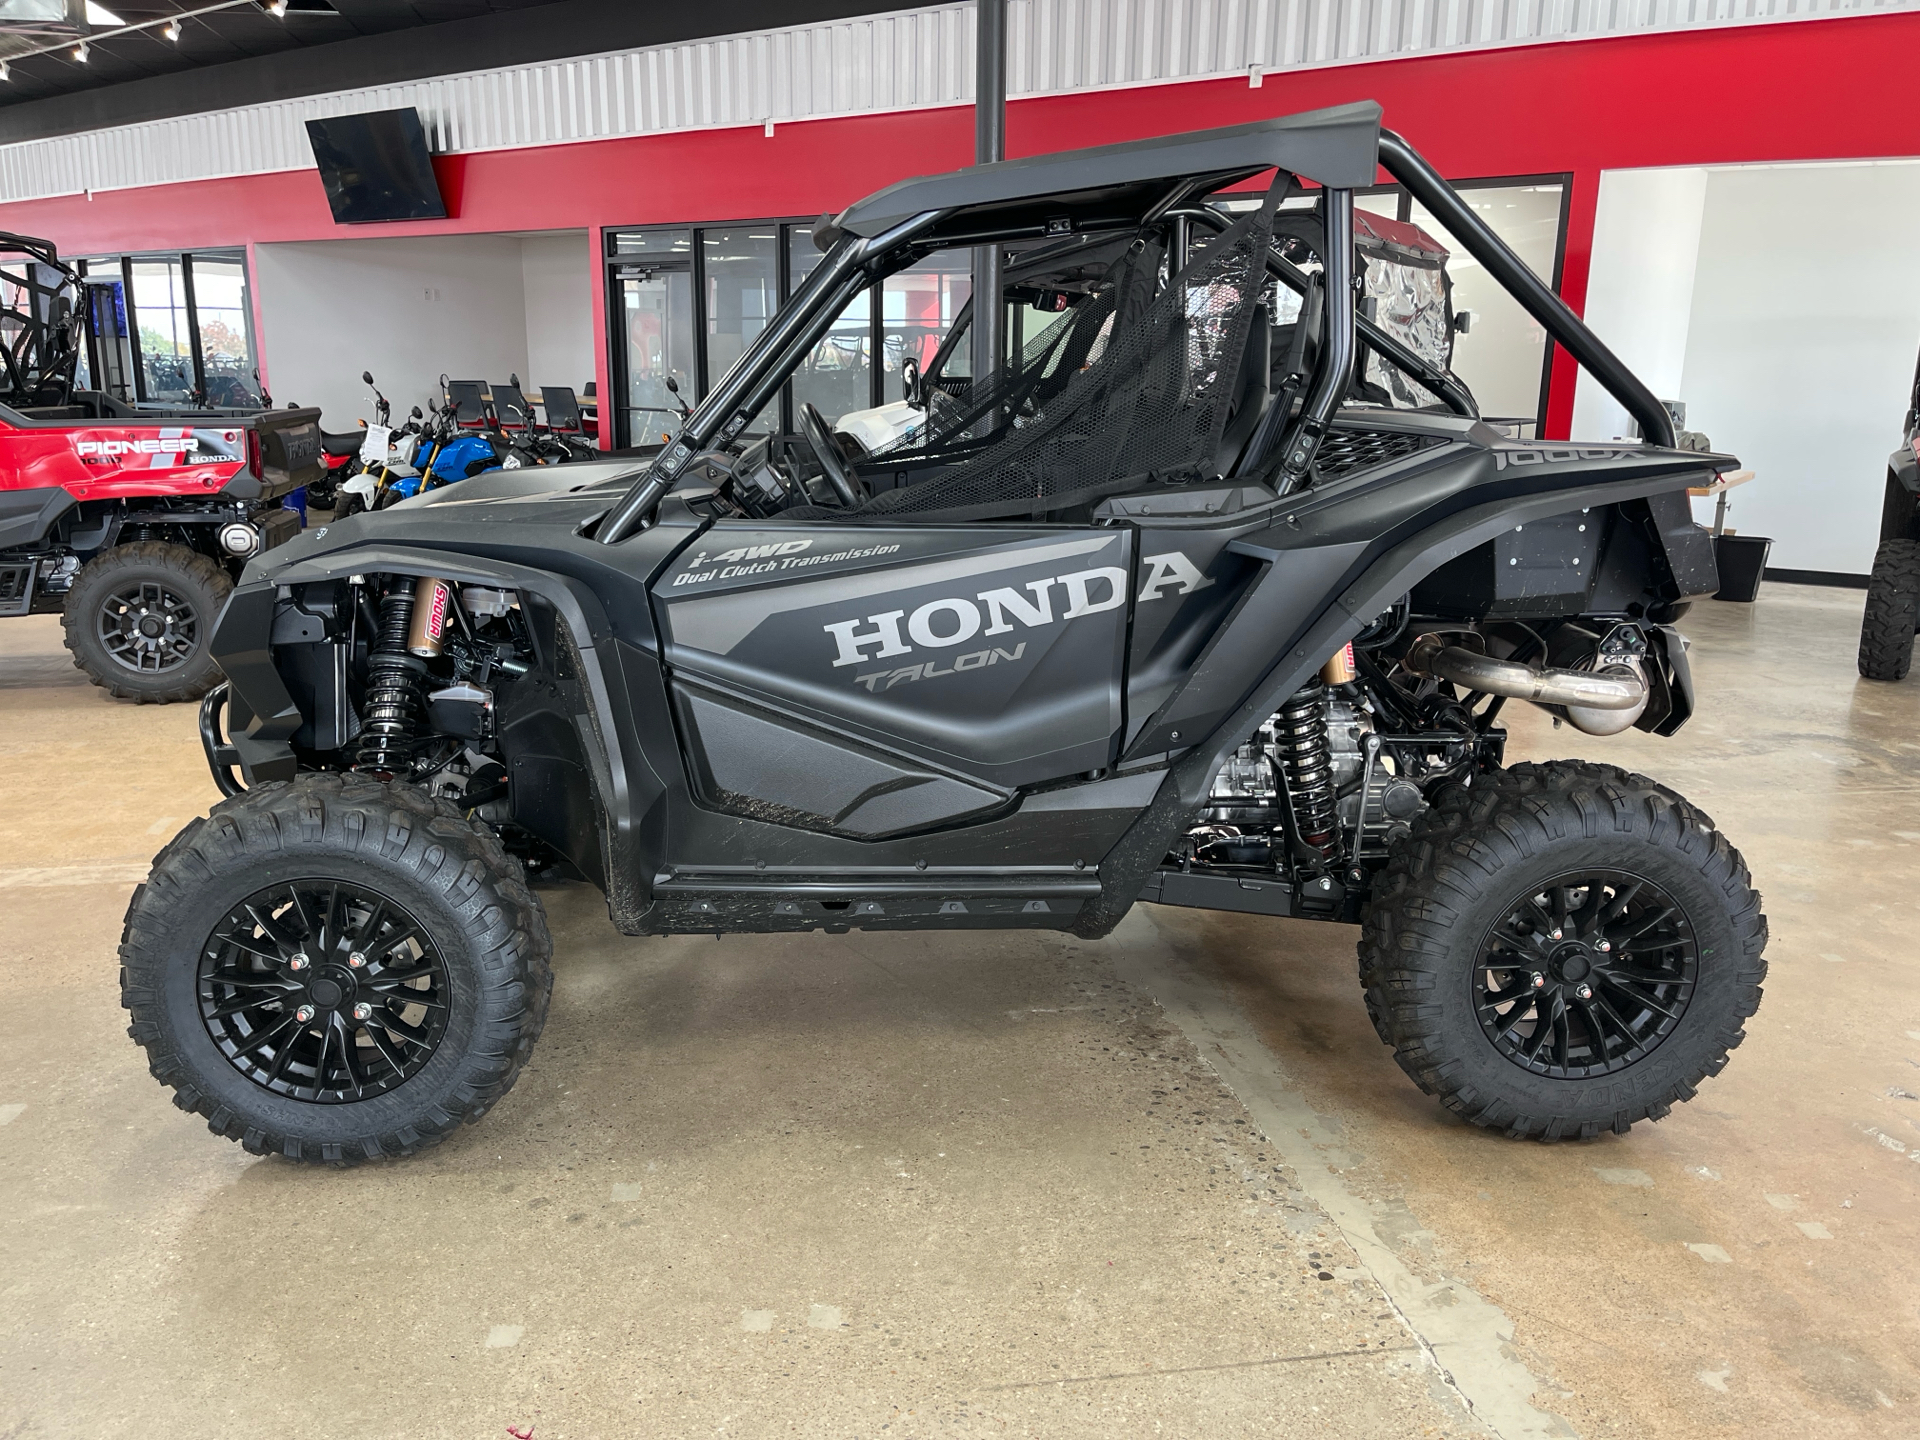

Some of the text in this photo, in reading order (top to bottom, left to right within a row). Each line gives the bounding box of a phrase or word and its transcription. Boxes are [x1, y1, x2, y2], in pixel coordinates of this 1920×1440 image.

[77, 438, 199, 456] PIONEER
[189, 453, 238, 465] HONDA
[1492, 449, 1647, 471] 1000X
[671, 544, 901, 587] Dual Clutch Transmission
[687, 539, 814, 569] i-4WD
[428, 584, 449, 640] SHOWA
[823, 551, 1217, 667] HONDA
[853, 641, 1027, 694] TALON
[1560, 1048, 1684, 1110] KENDA
